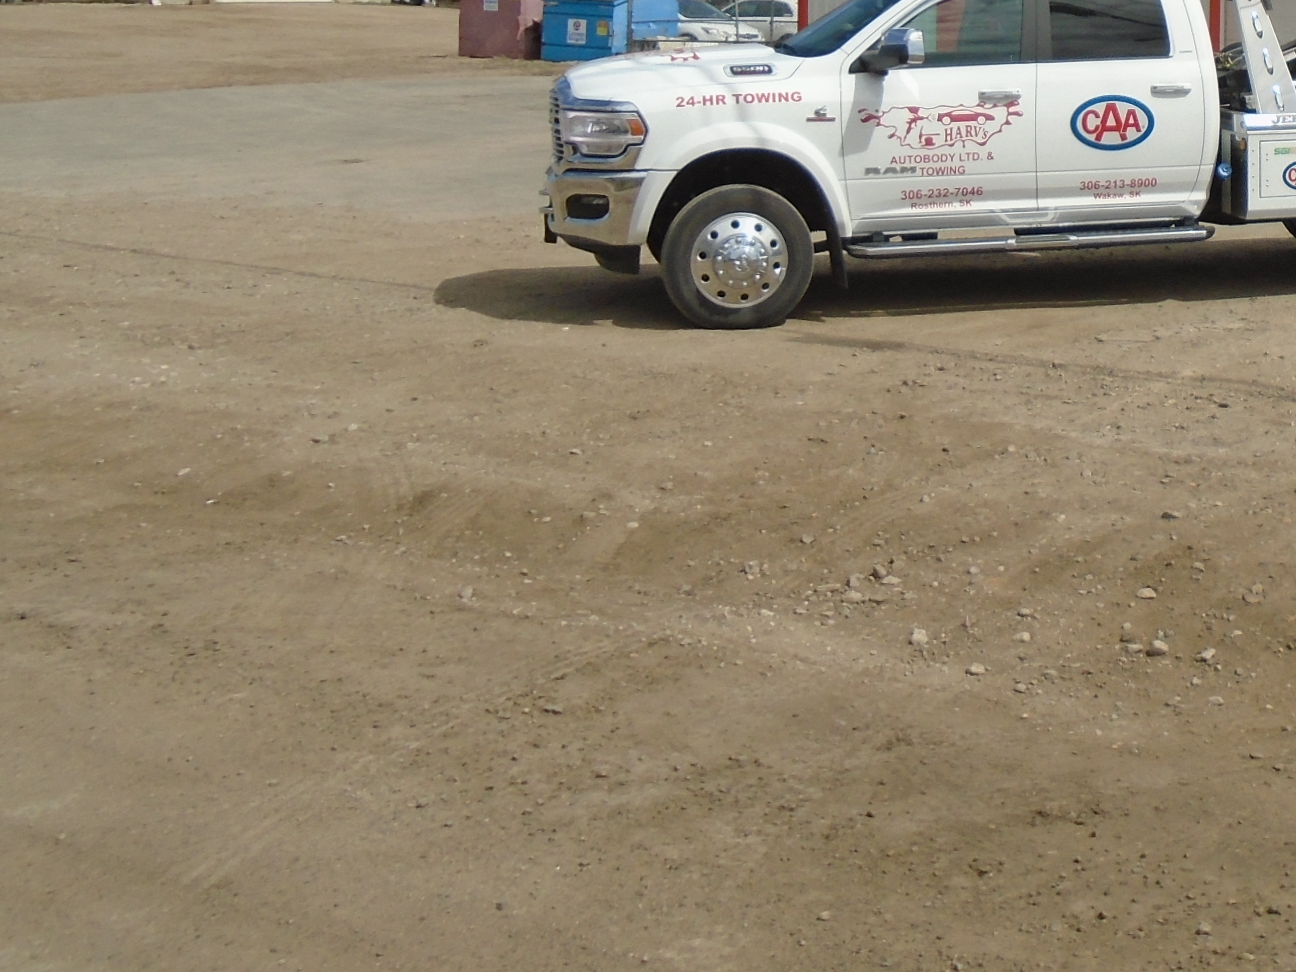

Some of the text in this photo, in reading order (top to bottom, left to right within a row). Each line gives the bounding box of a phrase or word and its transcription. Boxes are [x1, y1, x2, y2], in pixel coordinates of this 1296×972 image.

[676, 91, 802, 108] 24-HR TOWING
[1081, 102, 1142, 142] CAA
[890, 151, 994, 165] AUTOBODY LTD. &
[919, 166, 966, 176] TOWING
[1079, 177, 1157, 191] 306-213-8900
[900, 186, 984, 201] 306-232-7046
[1093, 190, 1141, 200] Wakaw, SK
[910, 199, 972, 210] Rosthern, SK
